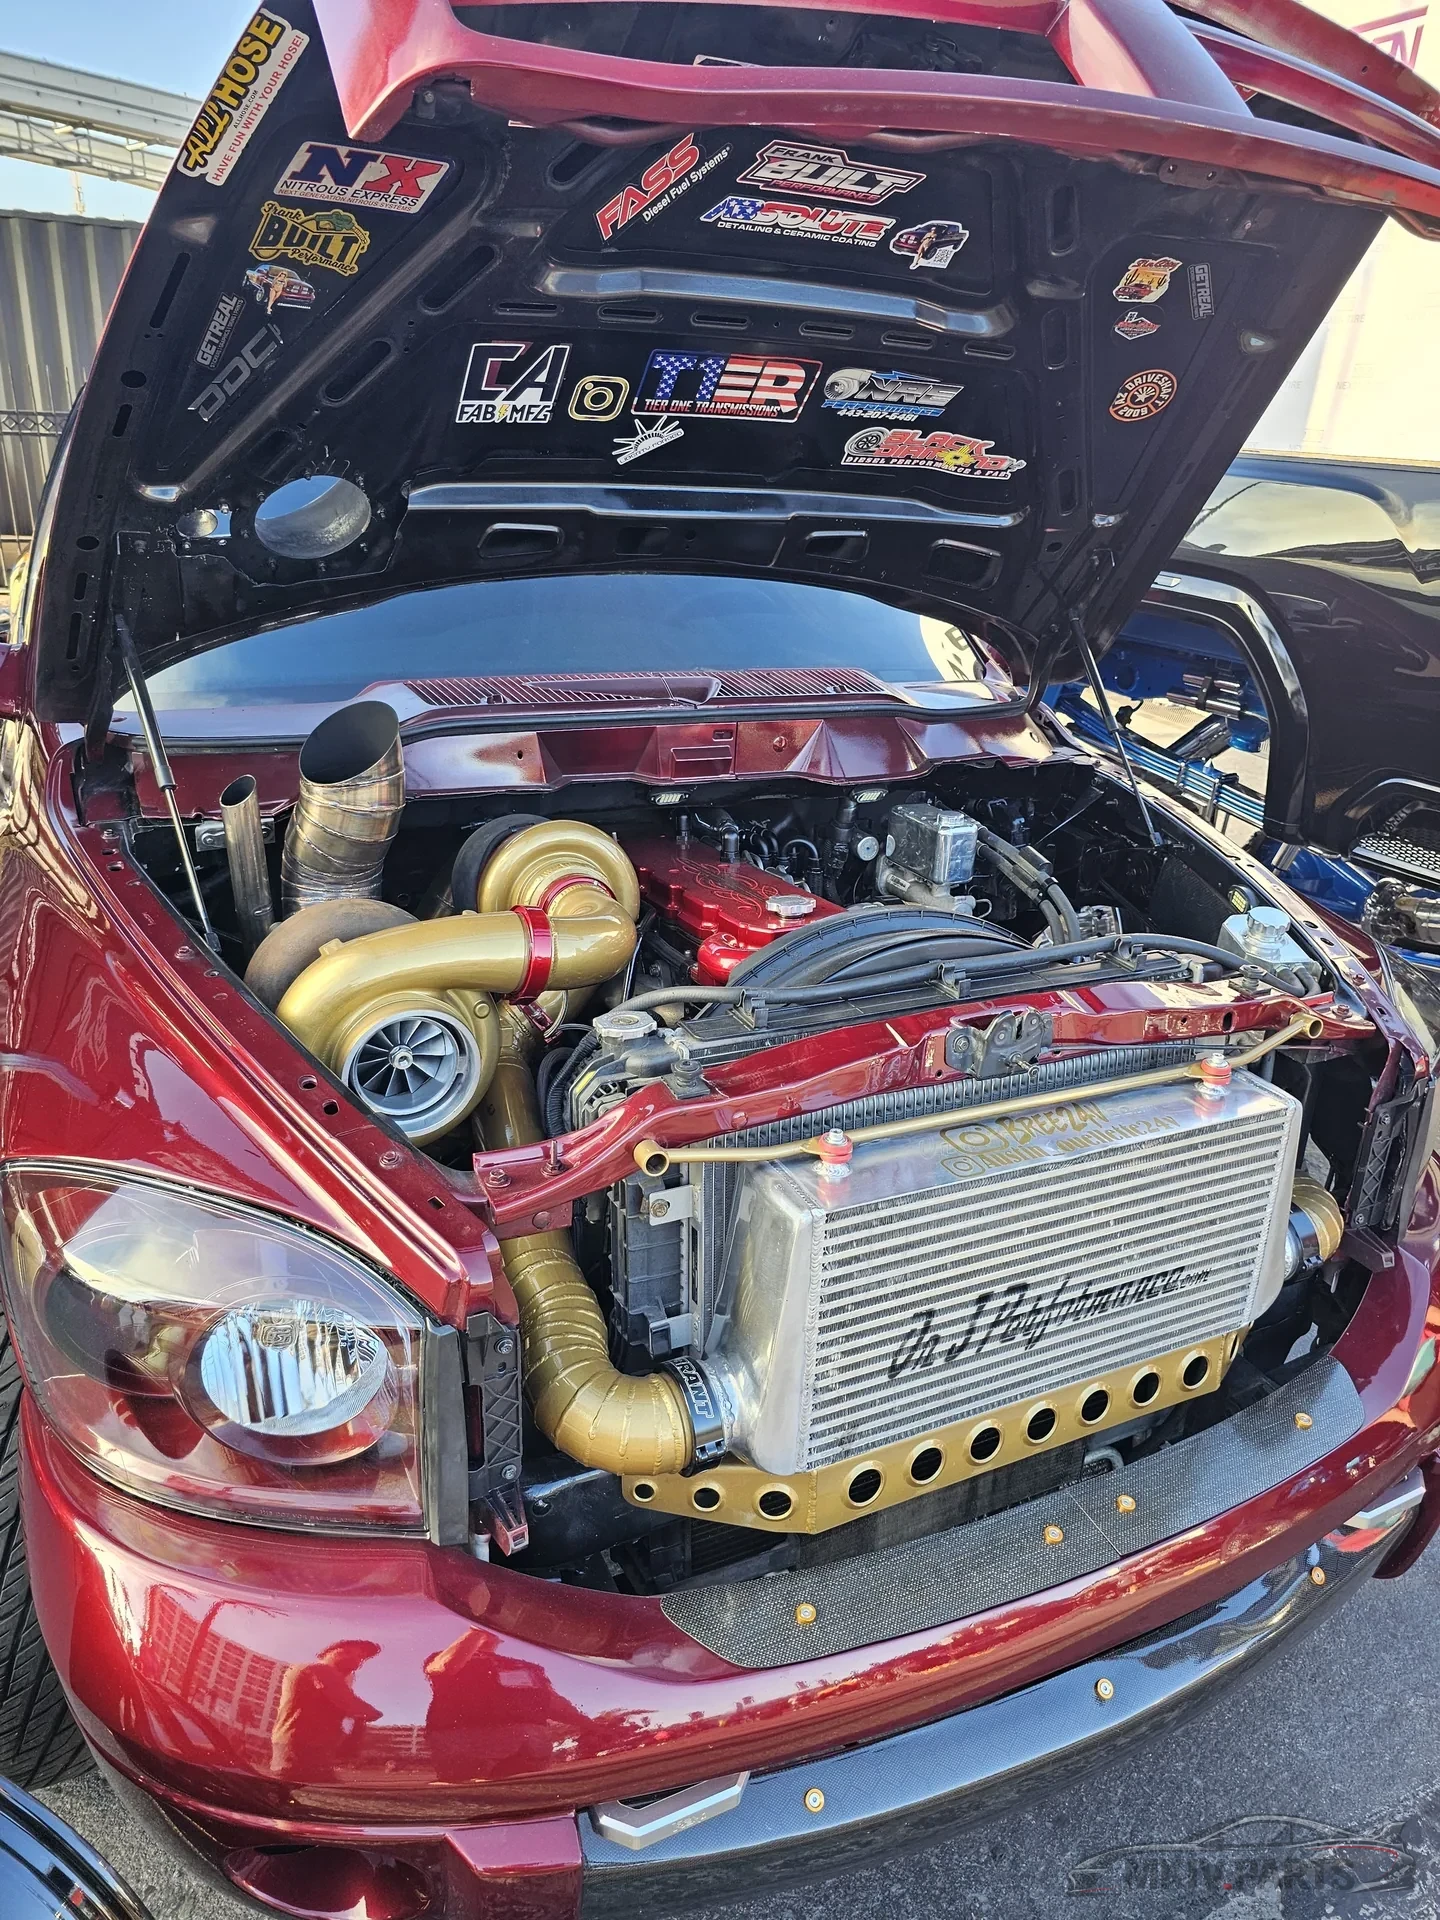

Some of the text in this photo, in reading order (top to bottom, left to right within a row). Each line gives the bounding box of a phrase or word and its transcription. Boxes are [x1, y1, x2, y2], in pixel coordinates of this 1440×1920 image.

[185, 15, 281, 169] ALL HOSE
[212, 34, 304, 182] HAVE FUN WITH YOUR HOSE!
[233, 89, 258, 129] ALLHOSE.COM
[770, 147, 839, 164] FRANK
[289, 144, 444, 199] NX
[754, 157, 911, 195] BUILT
[280, 180, 420, 208] NITROUS EXPRESS
[595, 132, 700, 240] FASS
[642, 194, 671, 222] Diesel
[669, 177, 691, 200] Fuel
[770, 179, 881, 202] PERFORMANCE
[264, 201, 302, 221] Frank
[278, 188, 413, 213] NEXT GENERATION NITROUS SYSTEMS
[258, 214, 360, 263] BUILT
[717, 221, 877, 248] DETAILING & CERAMIC COATING
[291, 248, 357, 275] Performance
[1194, 264, 1214, 318] GETREAL
[196, 292, 239, 367] GETREAL
[1114, 373, 1173, 407] AZ DRIVESHAFT
[645, 399, 781, 418] TIER ONE TRANSMISSIONS
[821, 399, 946, 418] PERFORMANCE
[1117, 406, 1149, 418] 2009
[882, 430, 993, 455] BLACK
[845, 456, 887, 465] DIESEL
